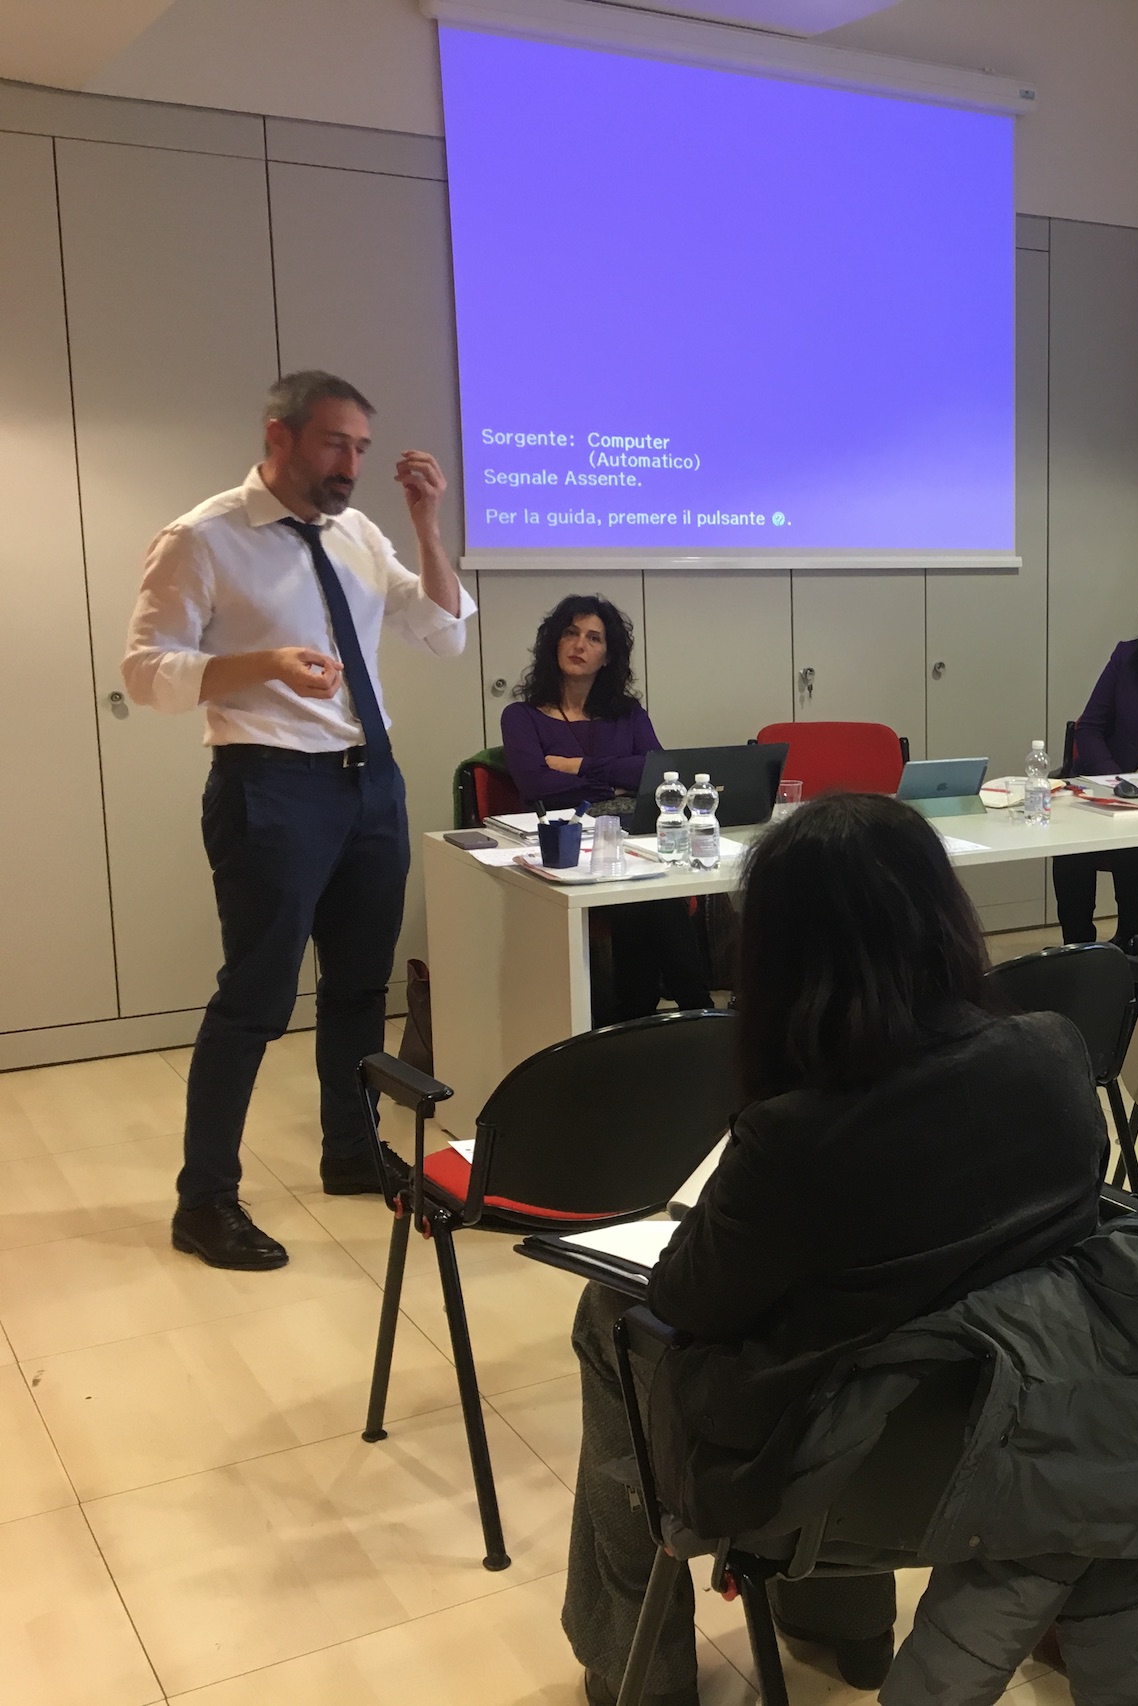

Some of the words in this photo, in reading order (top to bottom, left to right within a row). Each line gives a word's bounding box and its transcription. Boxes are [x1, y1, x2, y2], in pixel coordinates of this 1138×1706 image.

[481, 428, 575, 449] Sorgente:
[586, 431, 671, 452] Computer
[588, 451, 701, 471] (Automatico)
[484, 468, 558, 488] Segnale
[564, 471, 642, 488] Assente.
[485, 508, 518, 525] Per
[523, 507, 541, 525] la
[546, 508, 602, 528] guida,
[608, 511, 678, 528] premere
[682, 509, 692, 526] il
[696, 509, 766, 529] pulsante
